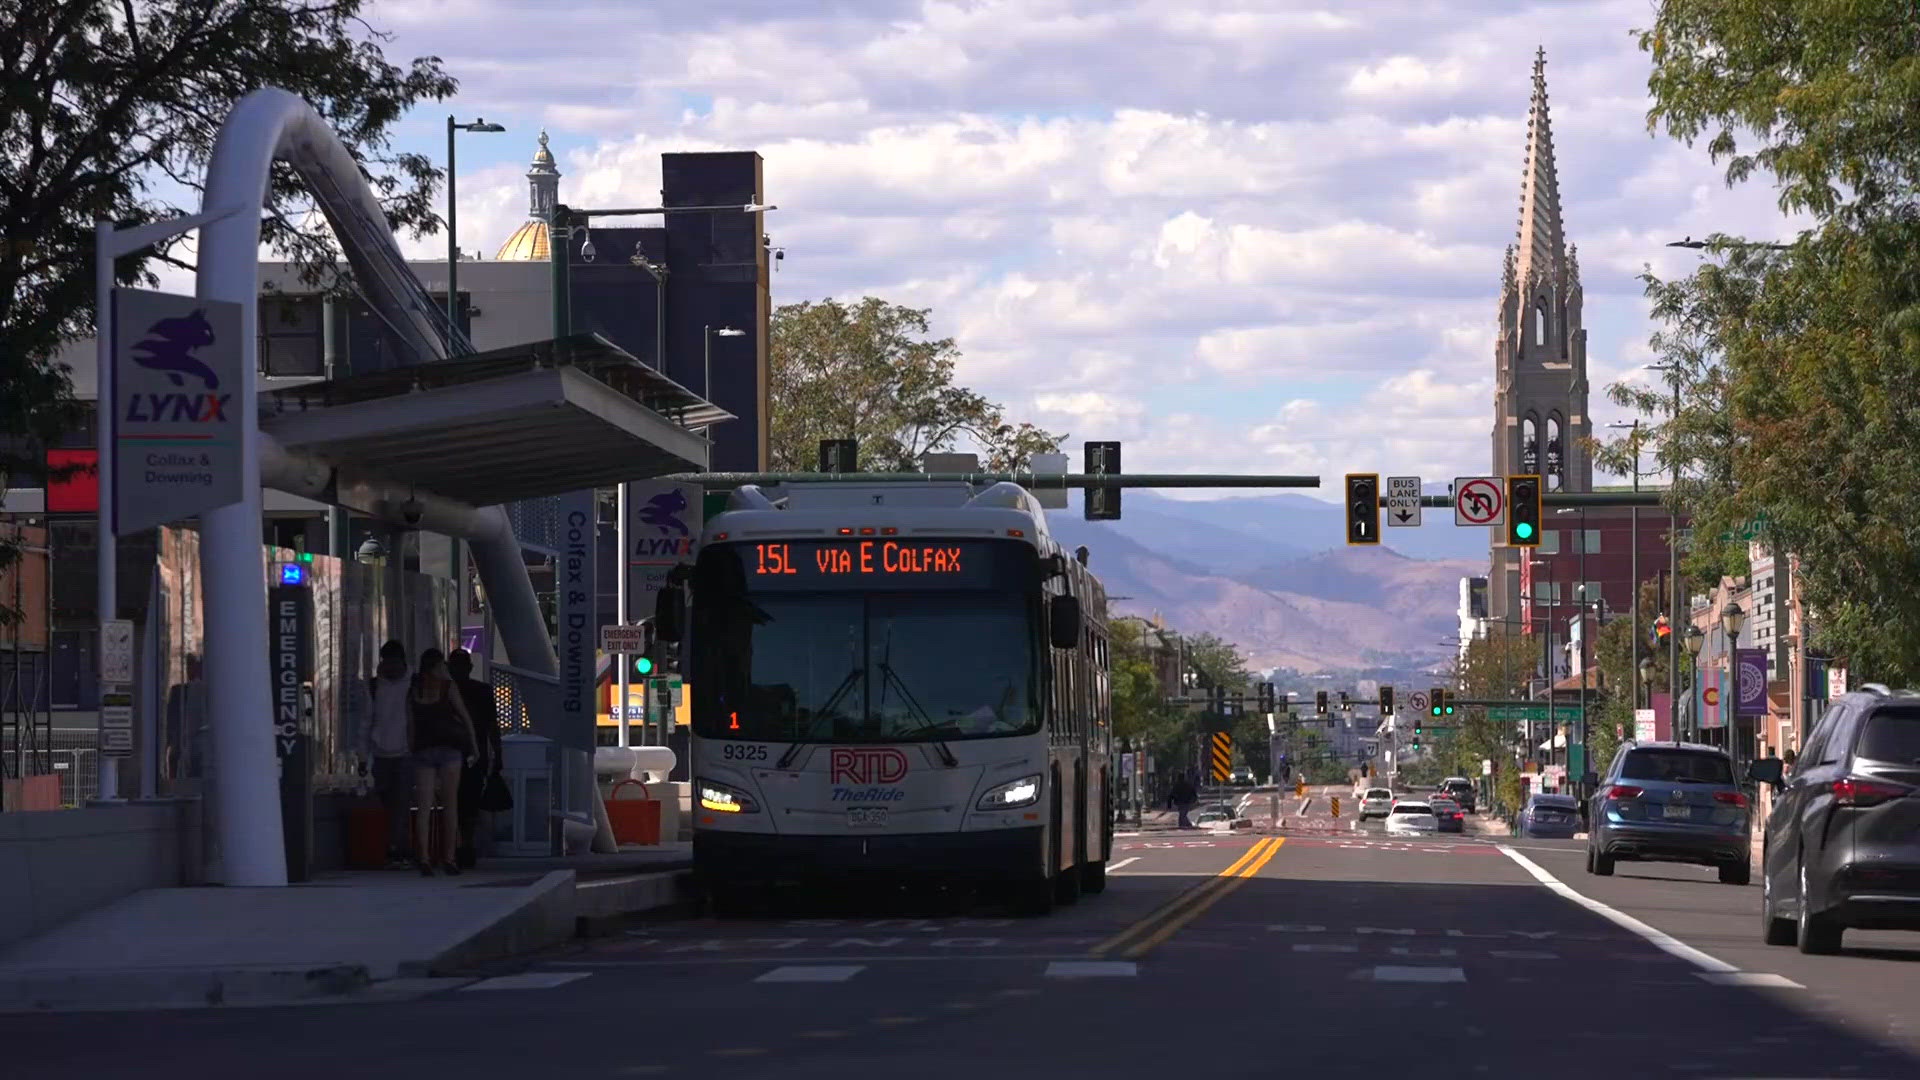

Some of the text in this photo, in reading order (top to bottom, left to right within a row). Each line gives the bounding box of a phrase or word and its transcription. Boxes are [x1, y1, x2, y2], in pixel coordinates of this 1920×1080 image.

[126, 393, 232, 422] LYNX
[146, 453, 210, 466] Colfax &
[145, 471, 213, 486] Downing
[1393, 479, 1415, 488] BUS
[1390, 489, 1418, 498] LANE
[1390, 499, 1418, 508] ONLY
[636, 538, 697, 555] LYNX
[756, 544, 797, 574] 15L
[816, 549, 851, 573] VIA
[860, 541, 874, 573] E
[563, 510, 587, 713] Colfax & Downing
[604, 629, 641, 640] EMERGENCY
[608, 641, 638, 650] EXIT ONLY
[279, 601, 297, 755] EMERGENCY
[729, 711, 740, 729] 1
[723, 744, 768, 760] 9325
[830, 747, 908, 784] RTD
